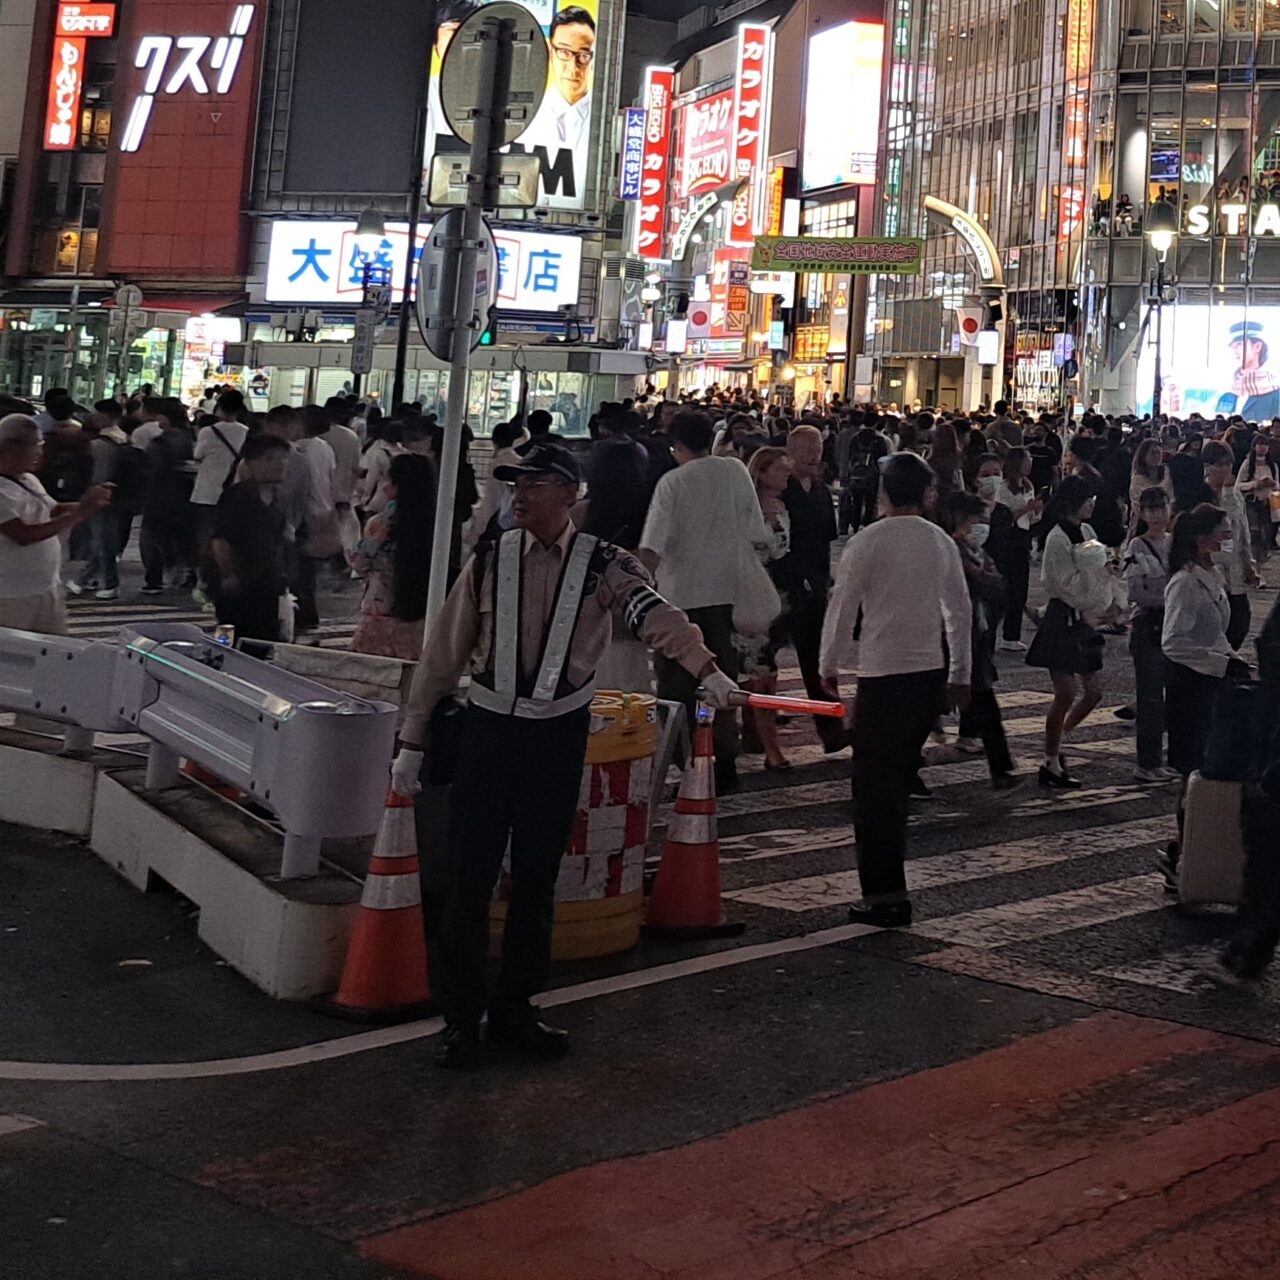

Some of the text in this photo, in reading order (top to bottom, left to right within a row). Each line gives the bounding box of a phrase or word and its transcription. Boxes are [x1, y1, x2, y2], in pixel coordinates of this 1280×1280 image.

[647, 83, 665, 144] BIG ECHO
[737, 40, 764, 147] カラオケ
[638, 152, 663, 248] カラオケ
[288, 238, 563, 294] 大盛店
